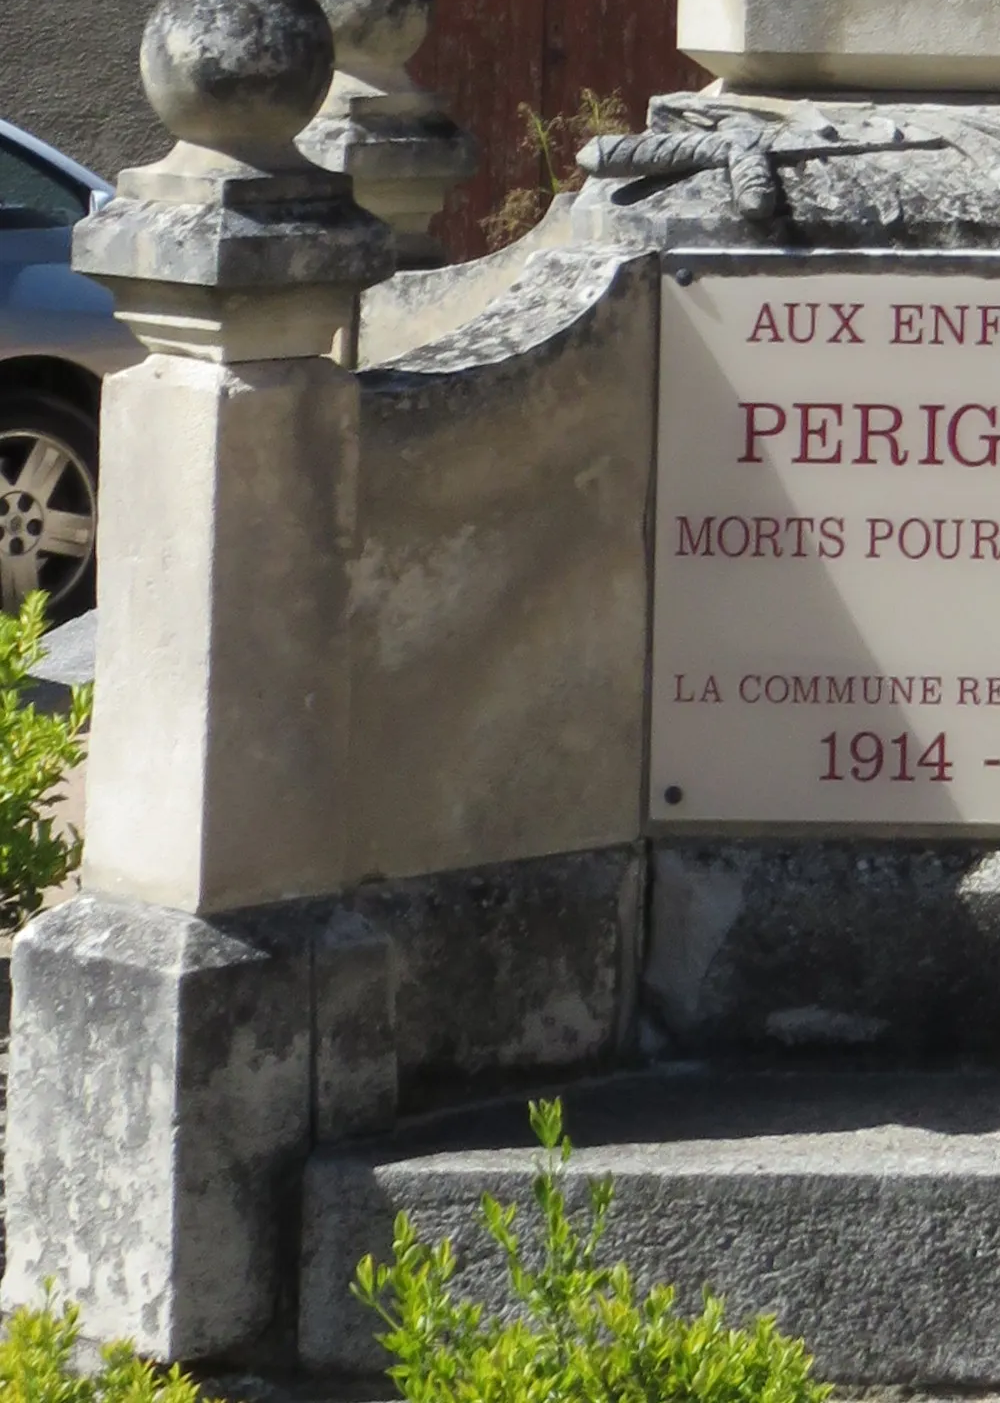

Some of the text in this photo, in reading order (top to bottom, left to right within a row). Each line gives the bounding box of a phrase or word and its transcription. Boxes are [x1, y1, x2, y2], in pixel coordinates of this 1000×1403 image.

[746, 303, 864, 343] AUX
[674, 516, 844, 558] MORTS
[674, 674, 720, 703] LA
[738, 674, 942, 705] COMMUNE
[818, 731, 953, 781] 1914
